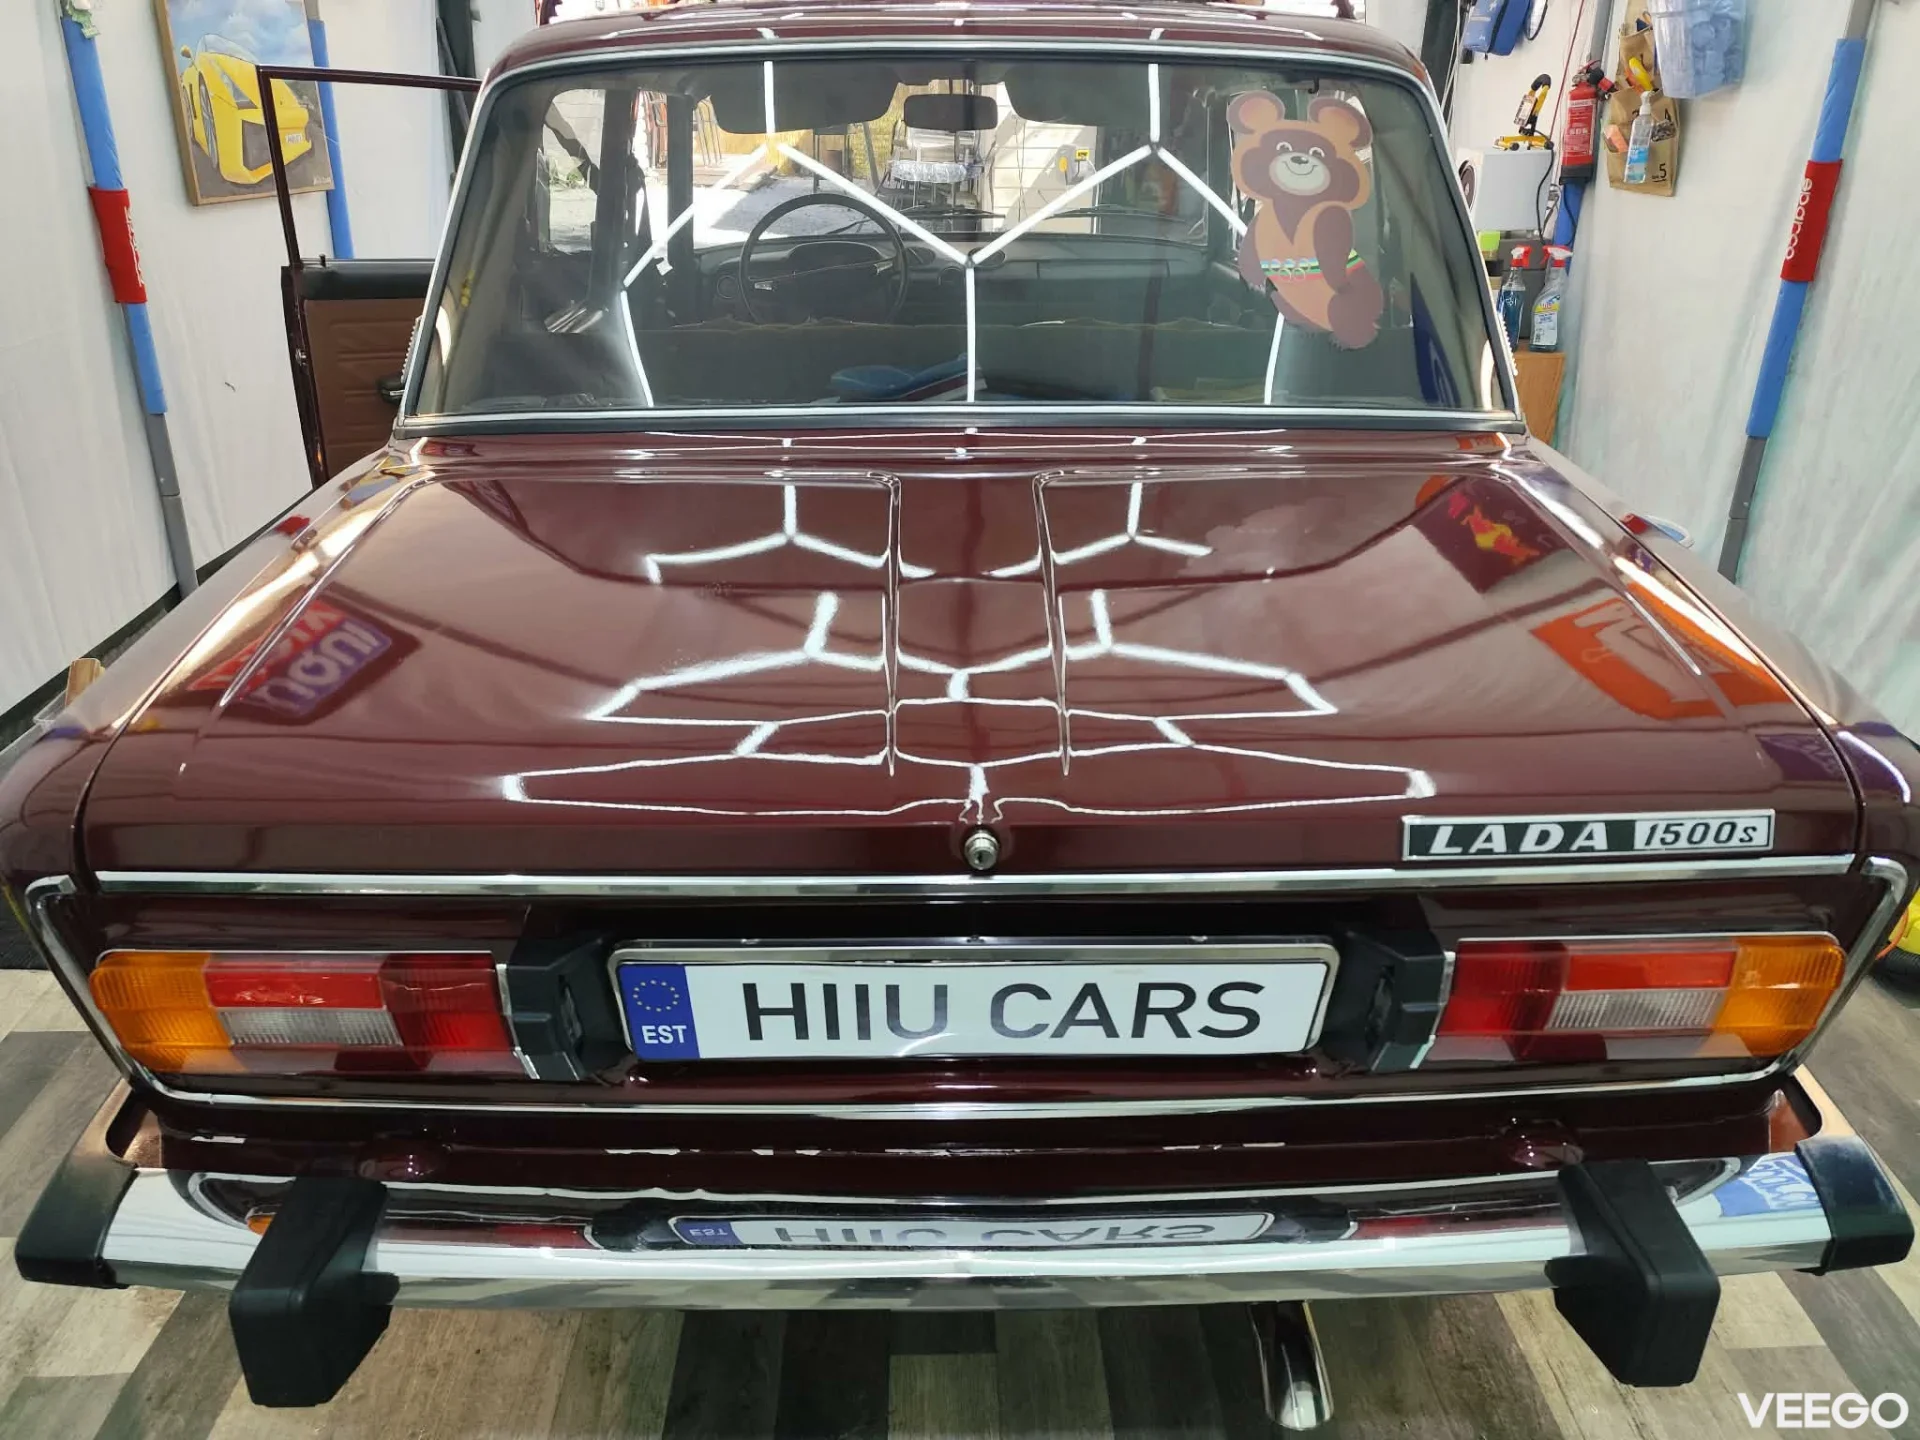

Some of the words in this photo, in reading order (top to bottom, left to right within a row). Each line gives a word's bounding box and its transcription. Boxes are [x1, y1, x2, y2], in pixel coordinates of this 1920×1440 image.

[1429, 822, 1608, 854] LADA
[743, 982, 948, 1041] HIIU
[989, 981, 1266, 1040] CARS
[642, 1024, 689, 1045] EST
